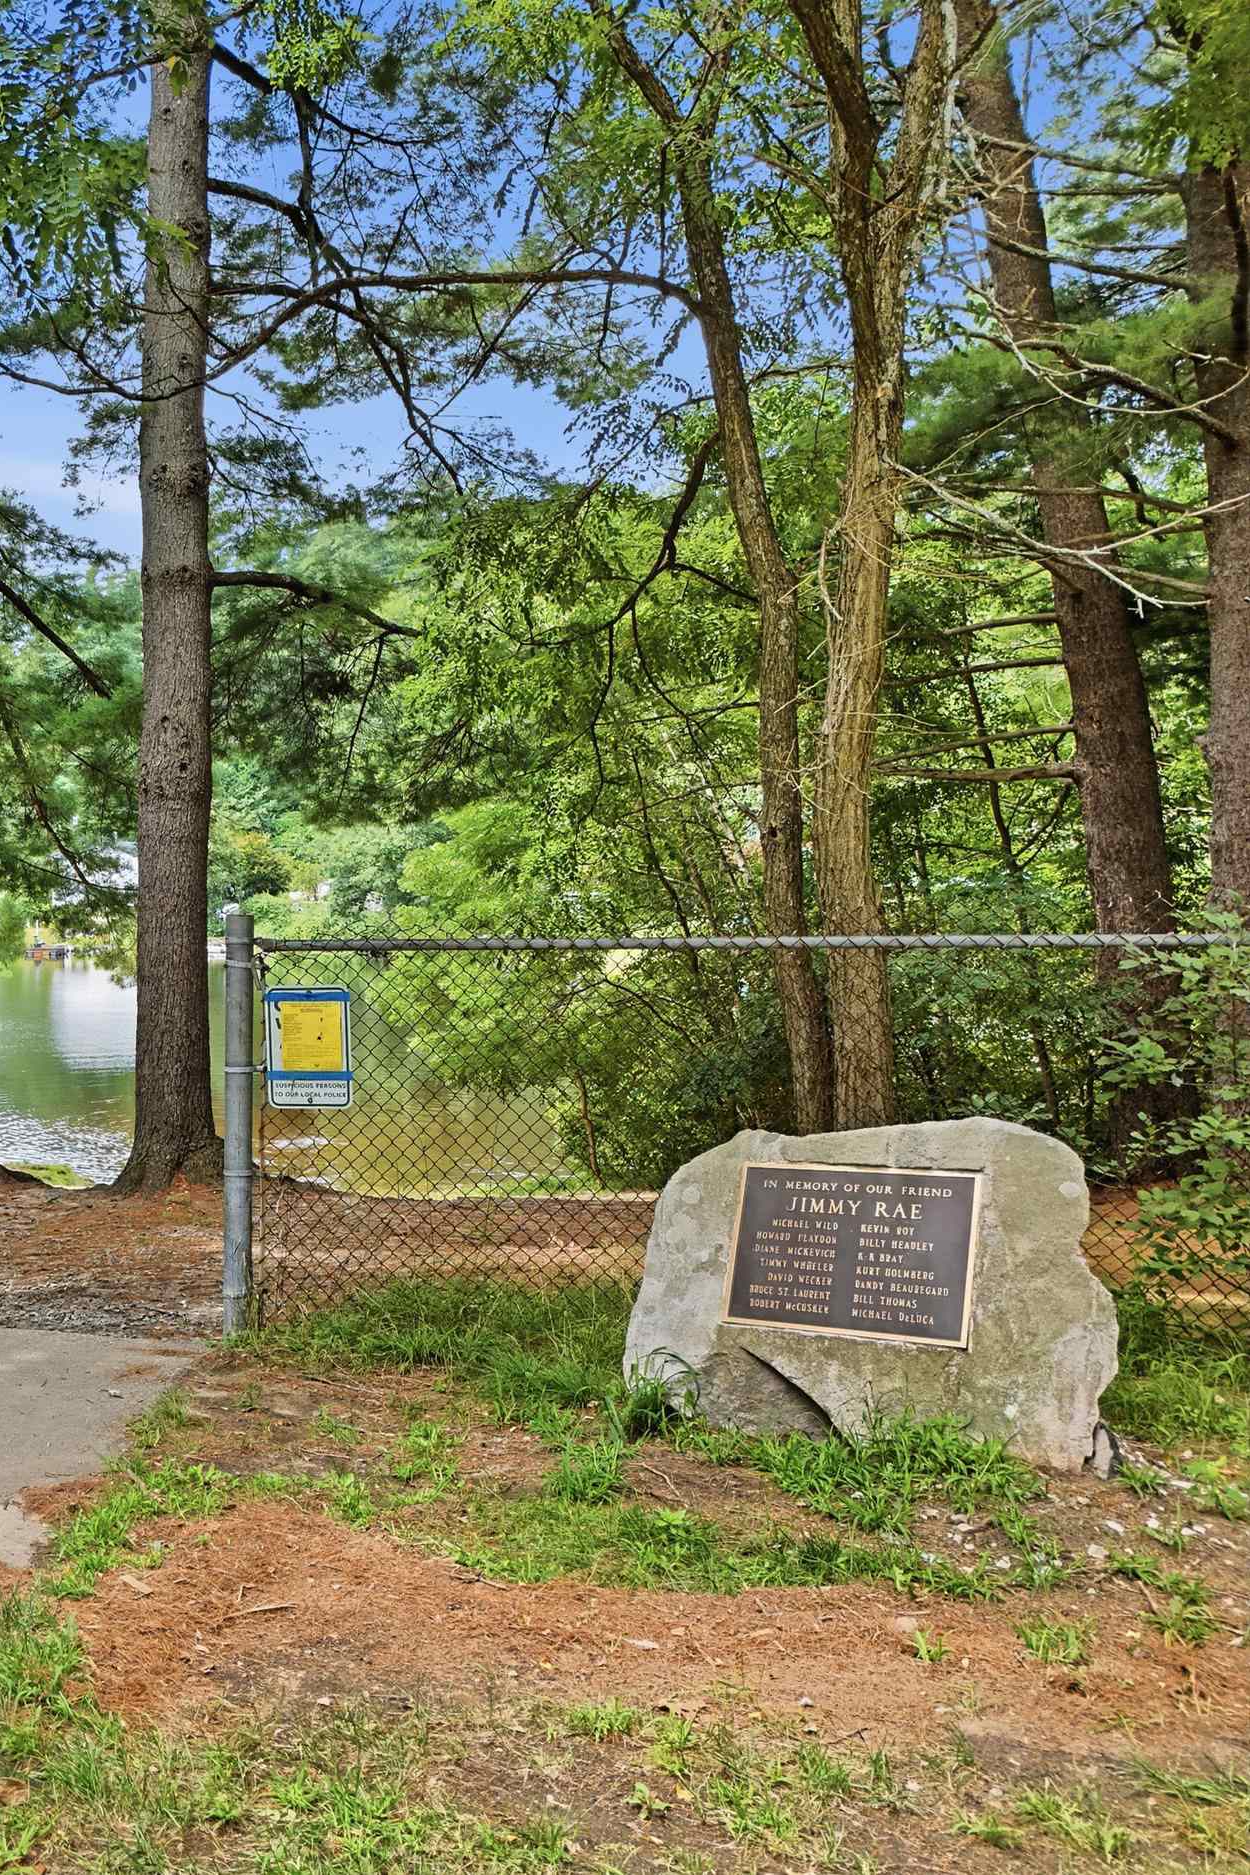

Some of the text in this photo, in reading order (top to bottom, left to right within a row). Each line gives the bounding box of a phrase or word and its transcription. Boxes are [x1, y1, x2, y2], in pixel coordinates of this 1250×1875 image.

[764, 1179, 953, 1198] IN MEMORY OF OUR FRIEND
[786, 1197, 923, 1220] JIMMY RAE
[772, 1219, 839, 1231] MICHAEL WILD
[860, 1224, 890, 1234] KEVIN
[756, 1231, 791, 1241] HOWARD
[755, 1243, 780, 1254] DIANE
[859, 1238, 934, 1251] BILLY HEADLEY
[760, 1258, 834, 1272] TIMMY WHEELER
[767, 1272, 793, 1282] DAVID
[856, 1266, 934, 1281] KURT HOLMBERG
[794, 1288, 831, 1300] LAURENT
[890, 1282, 949, 1297] BEAUREGARD
[749, 1298, 781, 1309] ROBERT
[853, 1294, 917, 1309] BILL THOMAS
[851, 1309, 934, 1325] MICHAEL DeLUCA
